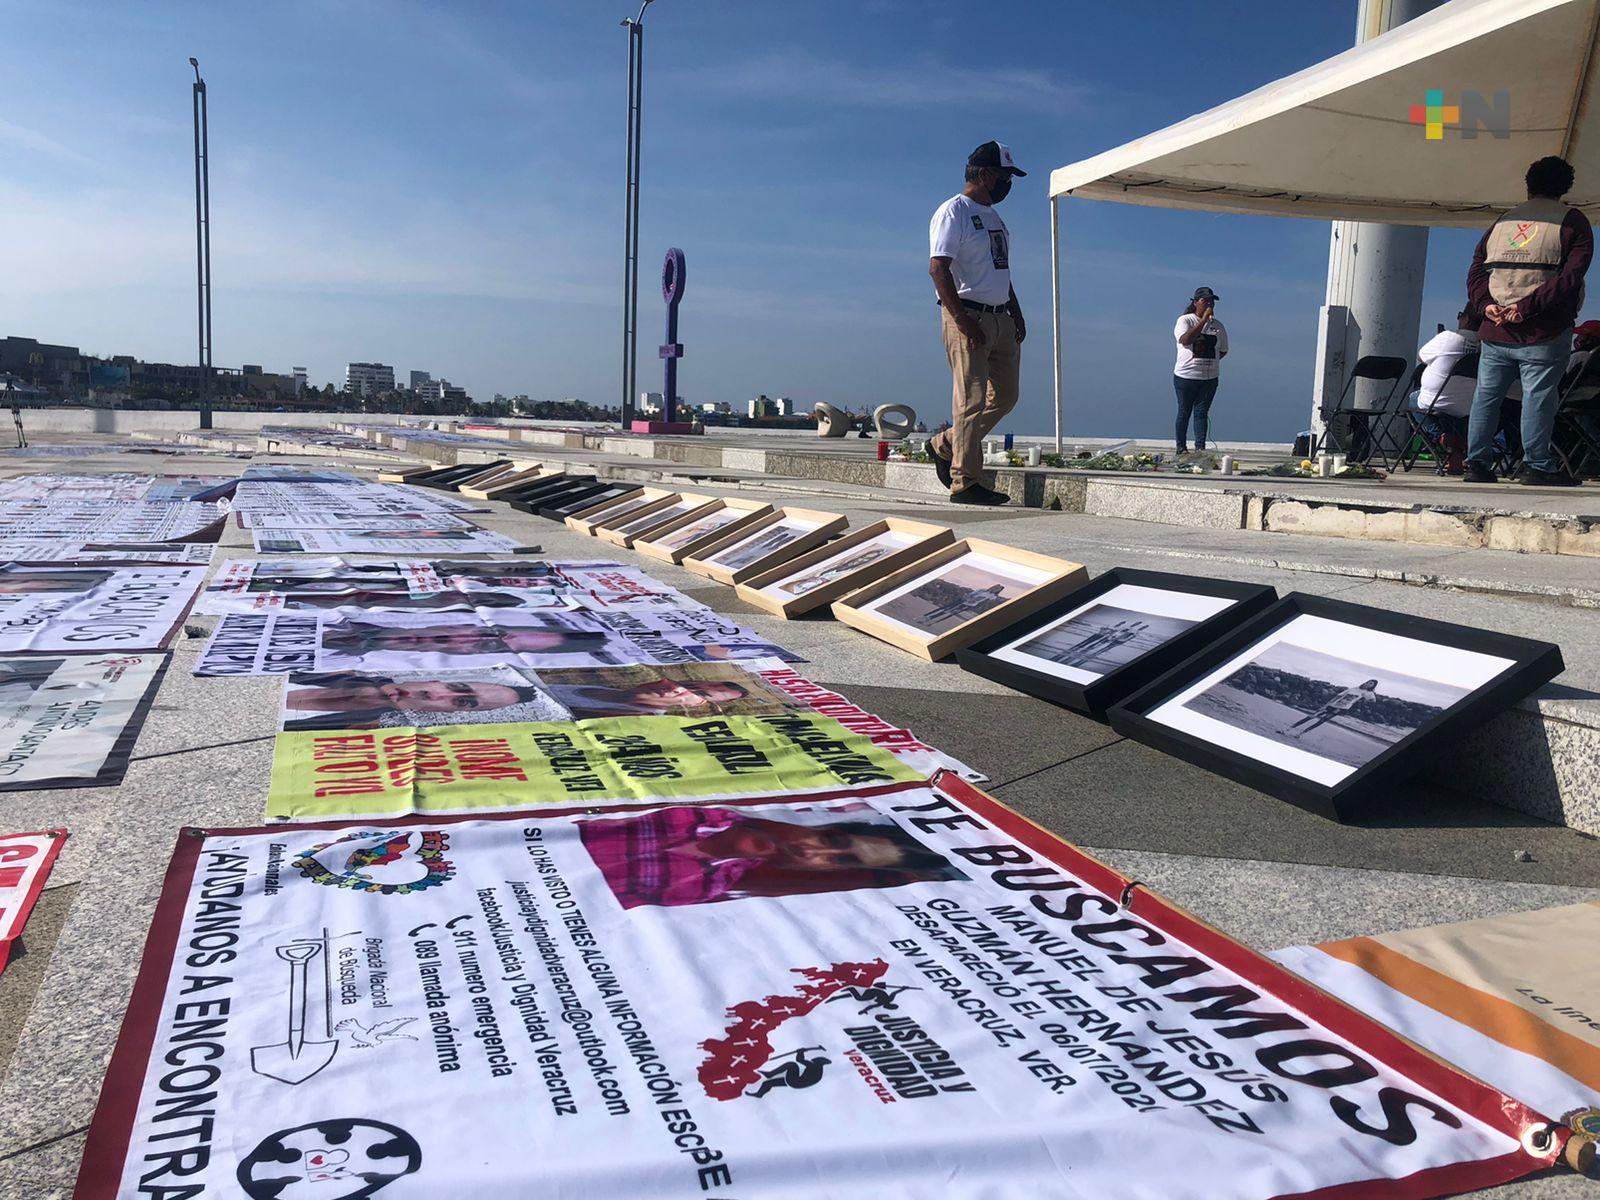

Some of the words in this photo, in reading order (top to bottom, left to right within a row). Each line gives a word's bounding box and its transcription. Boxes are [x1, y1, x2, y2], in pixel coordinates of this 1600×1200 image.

[523, 827, 543, 842] SI
[526, 845, 547, 856] LO
[533, 856, 558, 876] HAS
[542, 874, 571, 900] VISTO
[555, 900, 577, 909] O
[561, 909, 598, 948] TIENES
[338, 947, 356, 959] de
[362, 937, 387, 968] Brigada
[413, 939, 440, 959] 089
[452, 930, 478, 948] 911
[476, 887, 526, 974] facebook/Justicia
[179, 975, 234, 996] A
[336, 959, 362, 1005] Búsqueda
[418, 960, 451, 1009] llamada
[458, 950, 487, 994] numero
[501, 973, 526, 982] y
[578, 949, 624, 999] ALGUNA
[891, 794, 989, 836] TE
[951, 843, 1463, 1147] BUSCAMOS
[895, 905, 1027, 999] DESAPARECIÓ
[1009, 1000, 1047, 1020] EL
[505, 880, 631, 1116] justiciaydignidadveracruz@outlook.com
[509, 983, 556, 1043] Dignidad
[889, 938, 928, 957] EN
[915, 959, 1026, 1048] VERACRUZ,
[1018, 1050, 1077, 1095] VER.
[926, 898, 1046, 976] GUZMÁN
[1027, 980, 1266, 1135] HERNÁNDEZ
[984, 904, 1103, 982] MANUEL
[1095, 986, 1163, 1013] DE
[1146, 1020, 1289, 1103] JESÚS
[429, 1010, 462, 1073] anónima
[472, 996, 517, 1078] emergencia
[604, 999, 683, 1106] INFORMACIÓN
[875, 1013, 965, 1080] JUSTICIA
[534, 1043, 578, 1117] Veracruz
[843, 1025, 938, 1099] DIGNIDAD
